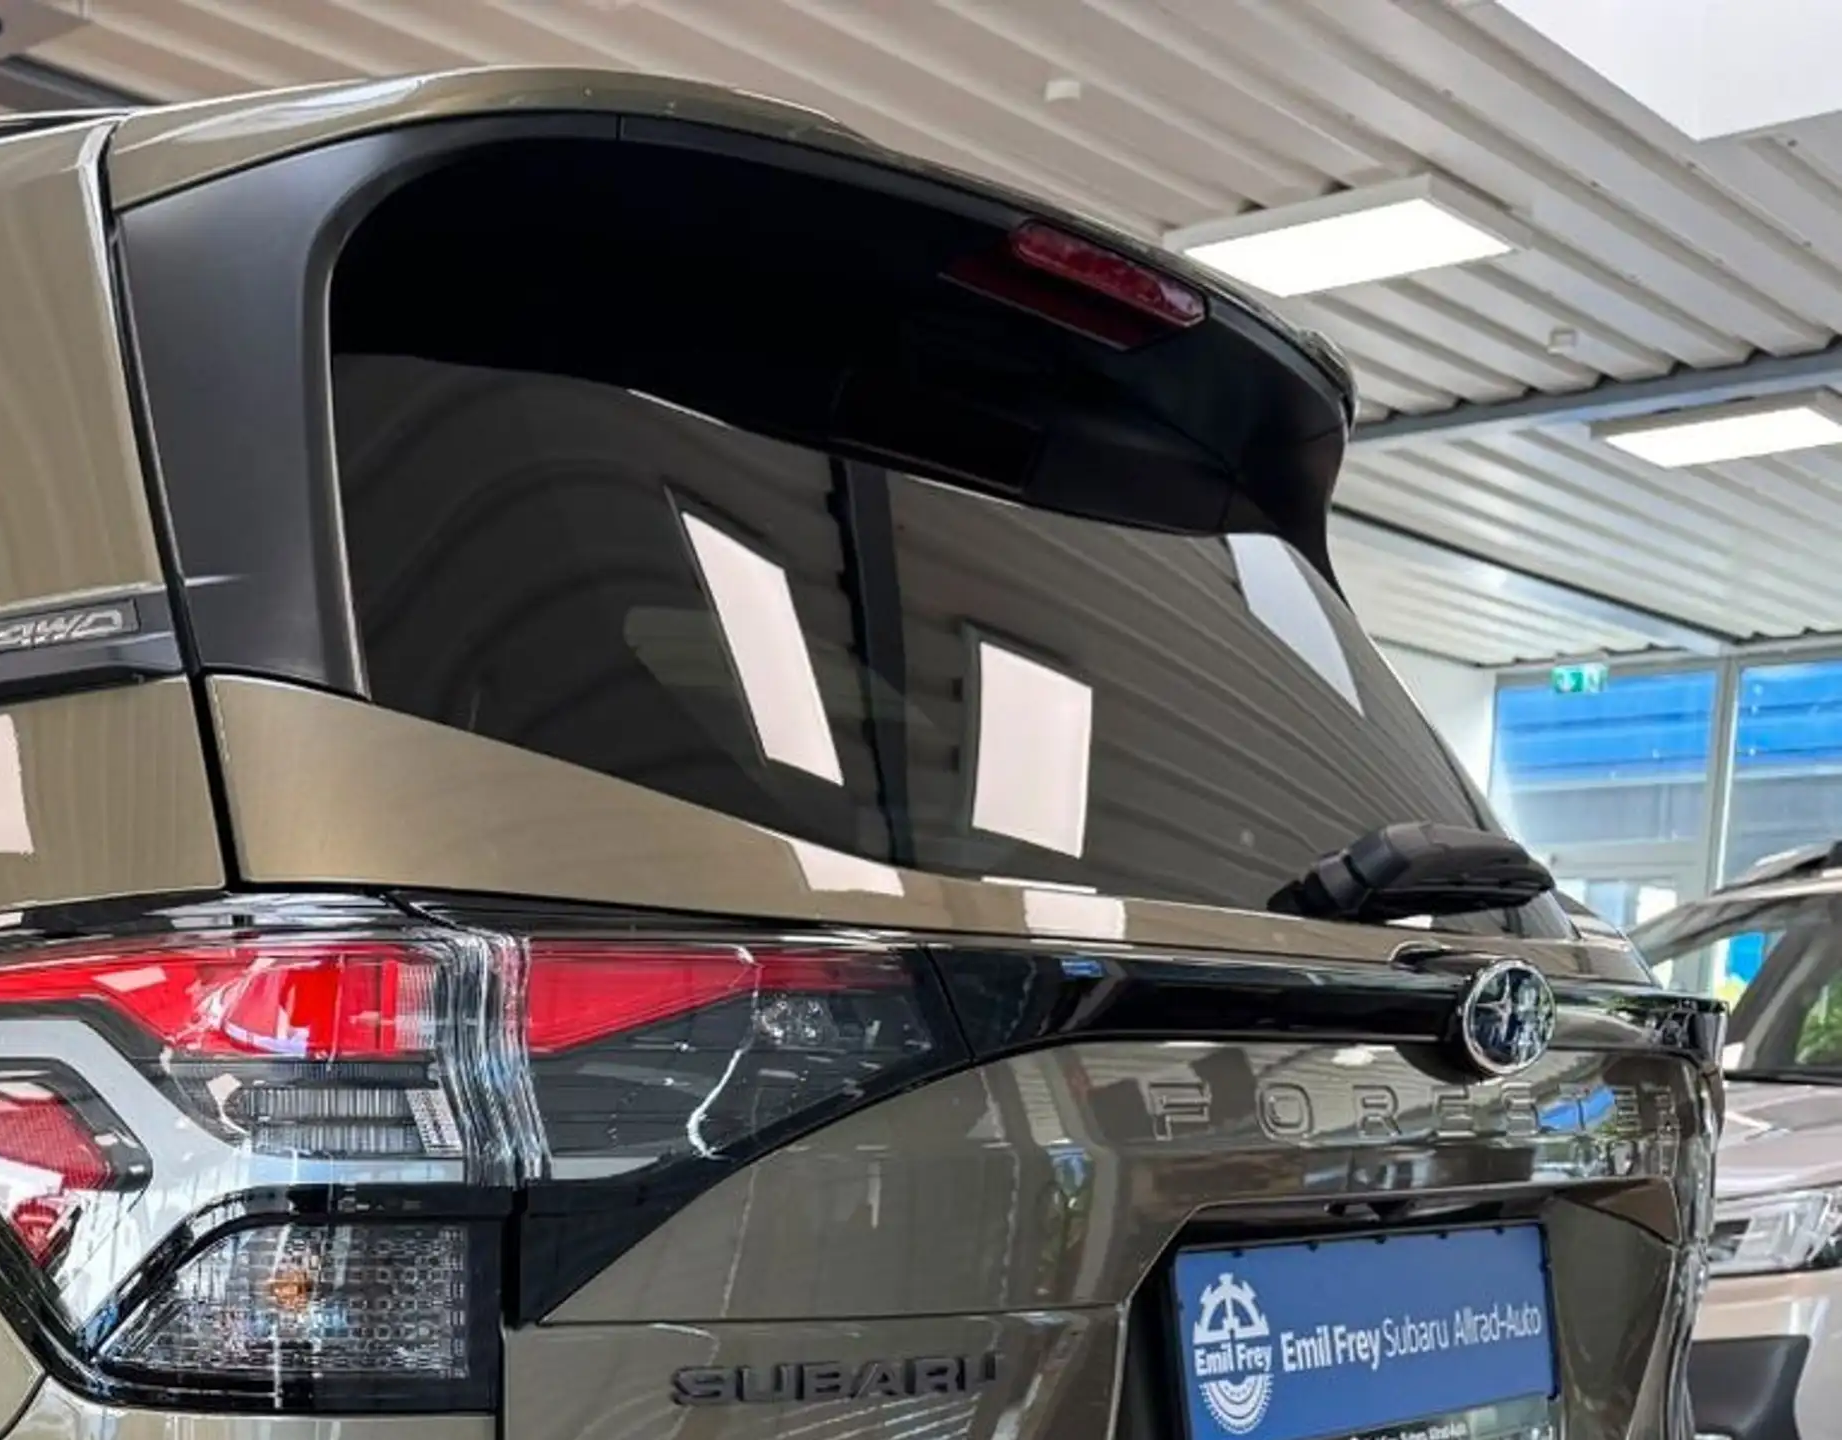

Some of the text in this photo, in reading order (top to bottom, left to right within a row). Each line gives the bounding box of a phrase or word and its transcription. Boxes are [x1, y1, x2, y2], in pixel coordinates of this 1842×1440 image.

[1194, 1343, 1272, 1376] Emil Frey
[1280, 1303, 1542, 1373] Emil Frey Subaru Allrad-Auto
[670, 1353, 1004, 1405] SUBARU
